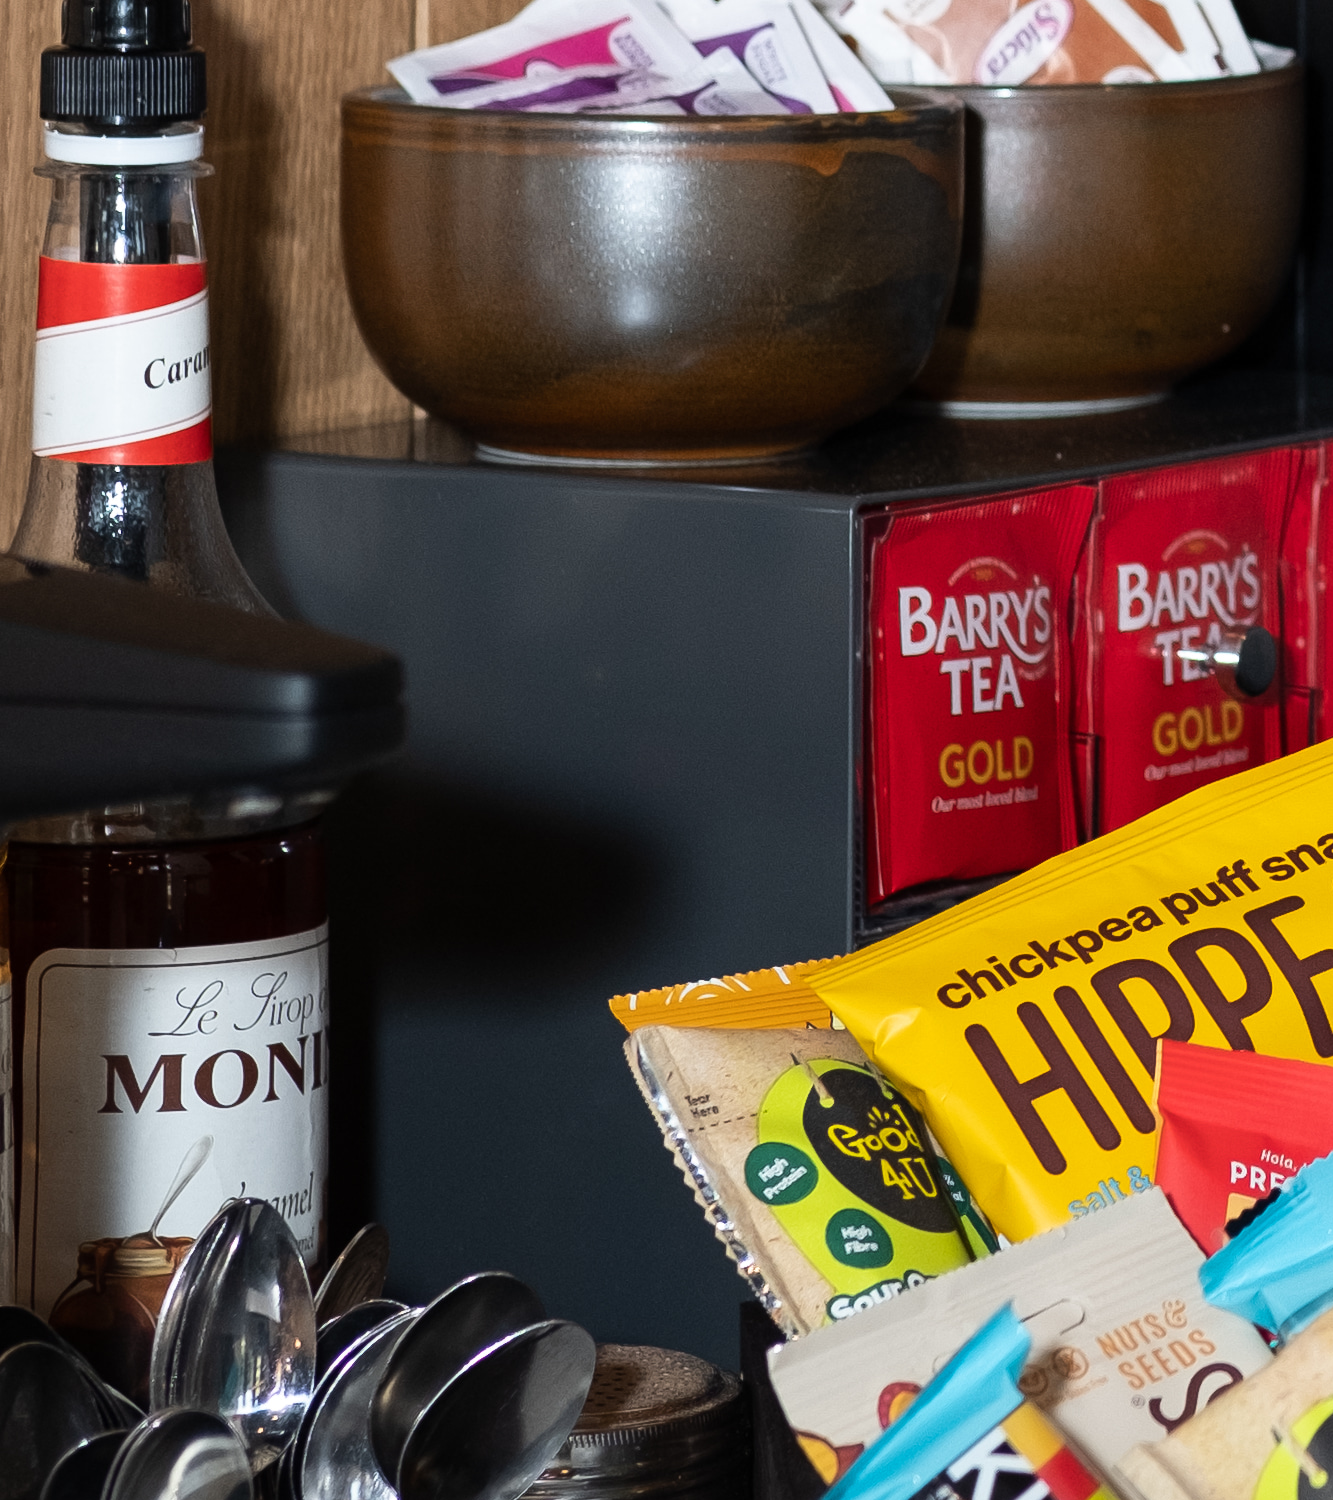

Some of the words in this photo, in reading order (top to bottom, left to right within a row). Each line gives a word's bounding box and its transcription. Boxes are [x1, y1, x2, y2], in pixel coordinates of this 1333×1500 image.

[1117, 543, 1261, 632] BARRY'S
[898, 574, 1051, 664] BARRY'S
[939, 654, 1024, 716] TEA
[1152, 699, 1244, 757] GOLD
[938, 736, 1035, 788] GOLD
[936, 903, 1163, 1010] chickpea
[1160, 859, 1263, 926] puff
[147, 980, 224, 1037] Le
[827, 1104, 926, 1161] Good
[881, 1158, 939, 1200] 4U
[1067, 1175, 1122, 1222] salt
[1123, 1165, 1153, 1198] &
[1096, 1313, 1167, 1359] NUTS
[1162, 1299, 1188, 1329] &
[1117, 1329, 1216, 1391] SEEDS
